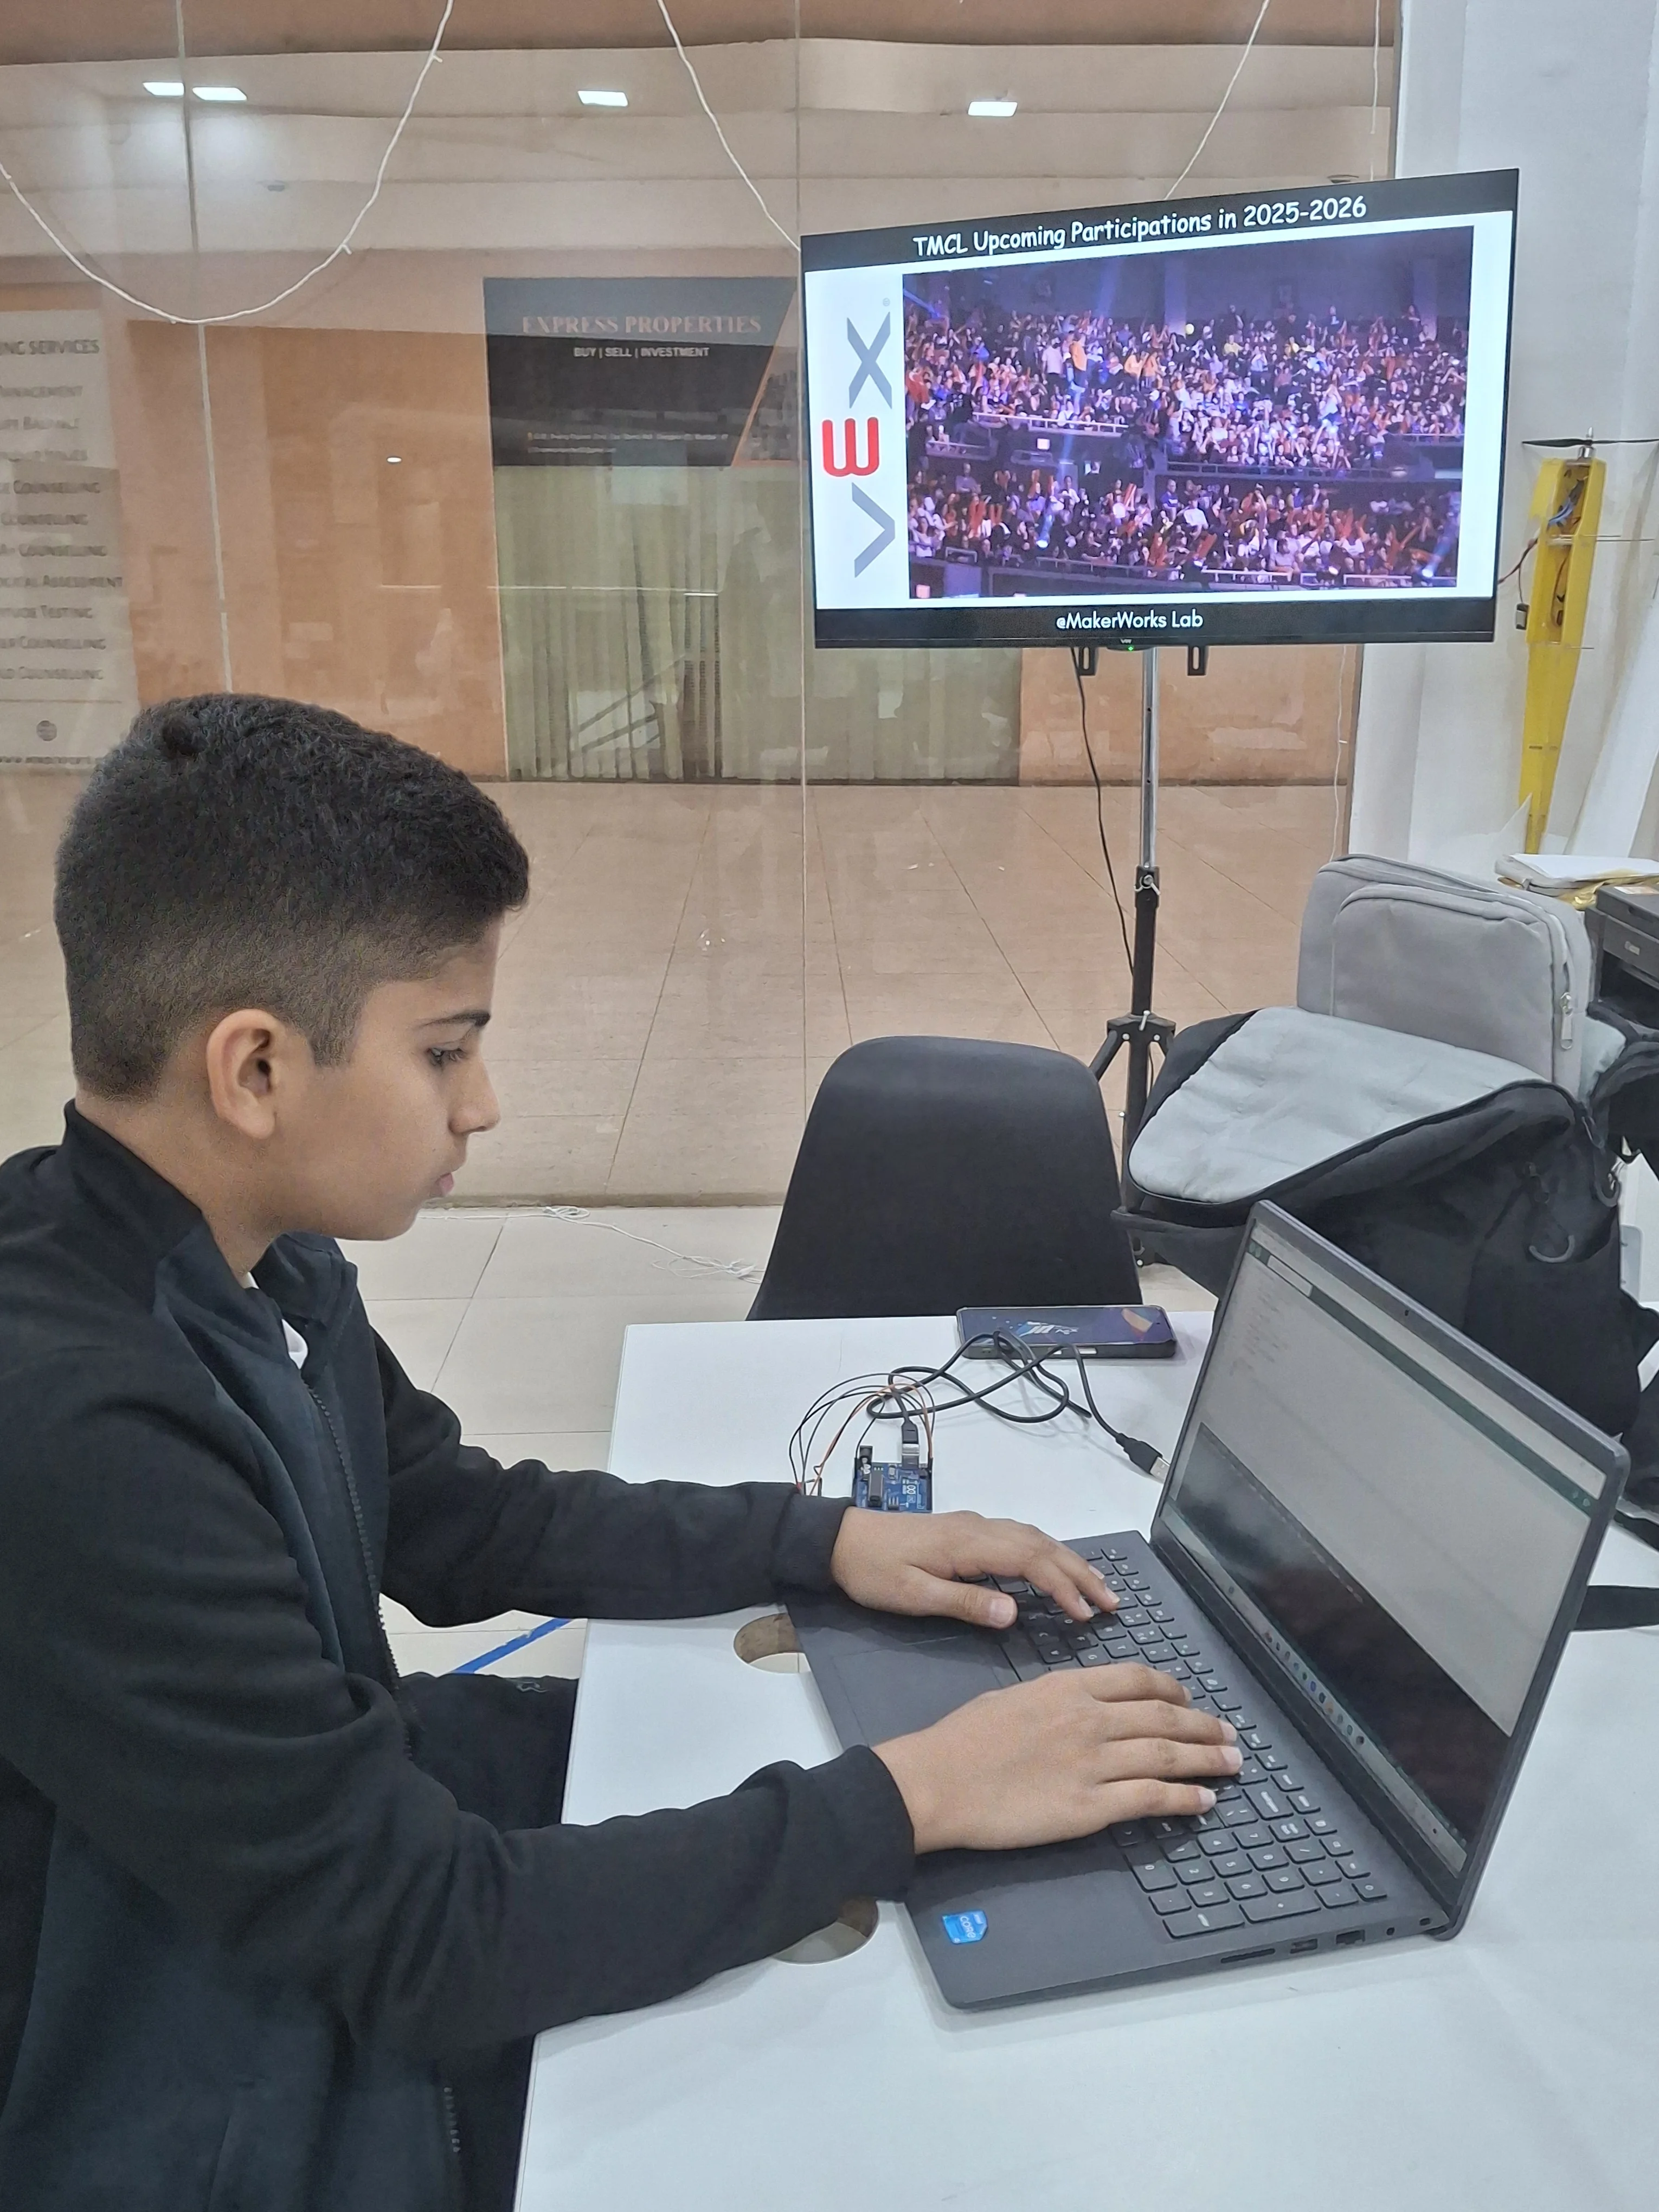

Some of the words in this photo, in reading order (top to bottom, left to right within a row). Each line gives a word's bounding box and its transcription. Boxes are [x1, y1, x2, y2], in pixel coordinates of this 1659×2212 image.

[912, 233, 968, 256] TMCL
[974, 224, 1066, 256] Upcoming
[1070, 213, 1212, 243] Participations
[1218, 208, 1237, 229] in
[1243, 195, 1367, 227] 2025-2026
[522, 315, 618, 334] EXPRESS
[625, 315, 762, 334] PROPERTIES
[573, 347, 596, 358] BUY
[604, 347, 632, 358] SELL
[640, 346, 710, 358] INVESTMENT
[1172, 608, 1204, 628] Lab
